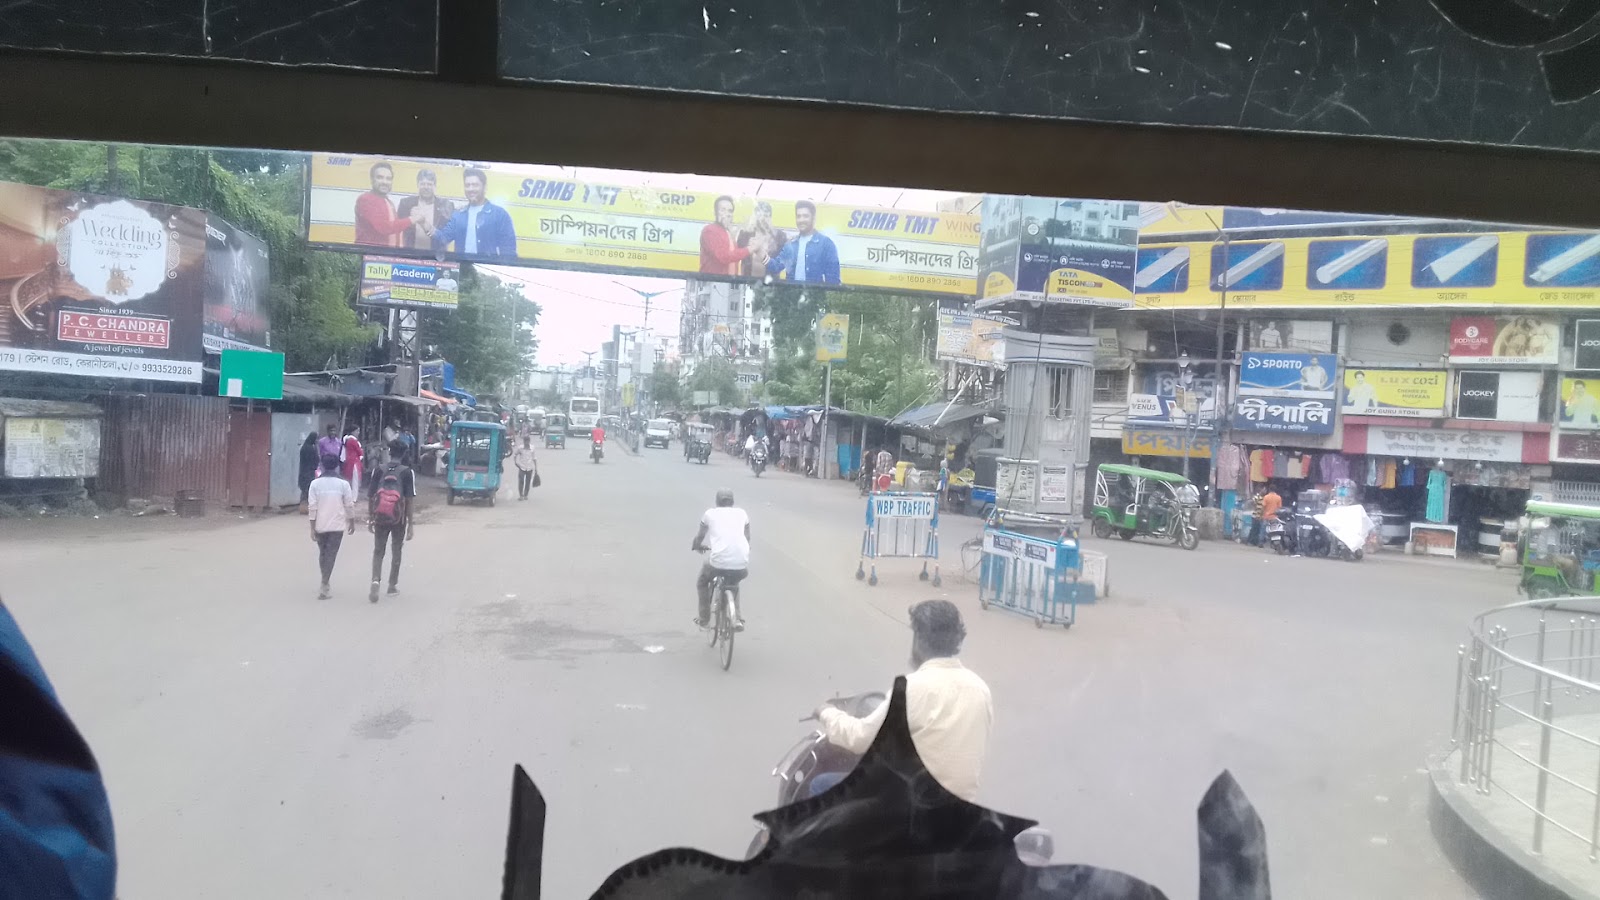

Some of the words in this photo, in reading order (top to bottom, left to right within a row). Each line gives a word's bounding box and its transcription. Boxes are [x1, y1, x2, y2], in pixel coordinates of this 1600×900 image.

[326, 156, 353, 166] SRMB
[517, 178, 576, 202] SRMB
[847, 209, 899, 231] SRMB
[903, 215, 940, 235] TMT
[82, 218, 162, 250] Wedding
[539, 214, 637, 241] চ্যাম্পিয়নদের
[643, 222, 675, 244] গ্রিপ
[91, 239, 149, 250] COLLECTION
[586, 248, 606, 257] 1800
[608, 249, 625, 258] 890
[627, 251, 648, 260] 2868
[866, 243, 954, 268] চ্যাম্পিয়নদের
[368, 265, 389, 276] Tally
[392, 267, 434, 281] Academy
[907, 275, 925, 283] 1800
[1057, 278, 1085, 287] TISCON
[98, 306, 117, 314] Since
[119, 308, 134, 316] 1939
[63, 314, 74, 326] P.
[79, 316, 93, 328] C.
[97, 317, 166, 333] CHANDRA
[62, 327, 166, 343] JEWELLERS
[83, 343, 90, 351] A
[90, 344, 111, 353] jewel
[121, 345, 145, 354] jewels
[141, 363, 193, 376] 9933529286
[1262, 359, 1303, 369] SPORTO
[1412, 374, 1439, 385] cozi
[1131, 403, 1157, 411] VENUS
[1236, 398, 1332, 425] দীপালি
[876, 499, 894, 515] WBP
[897, 500, 931, 516] TRAFFIC
